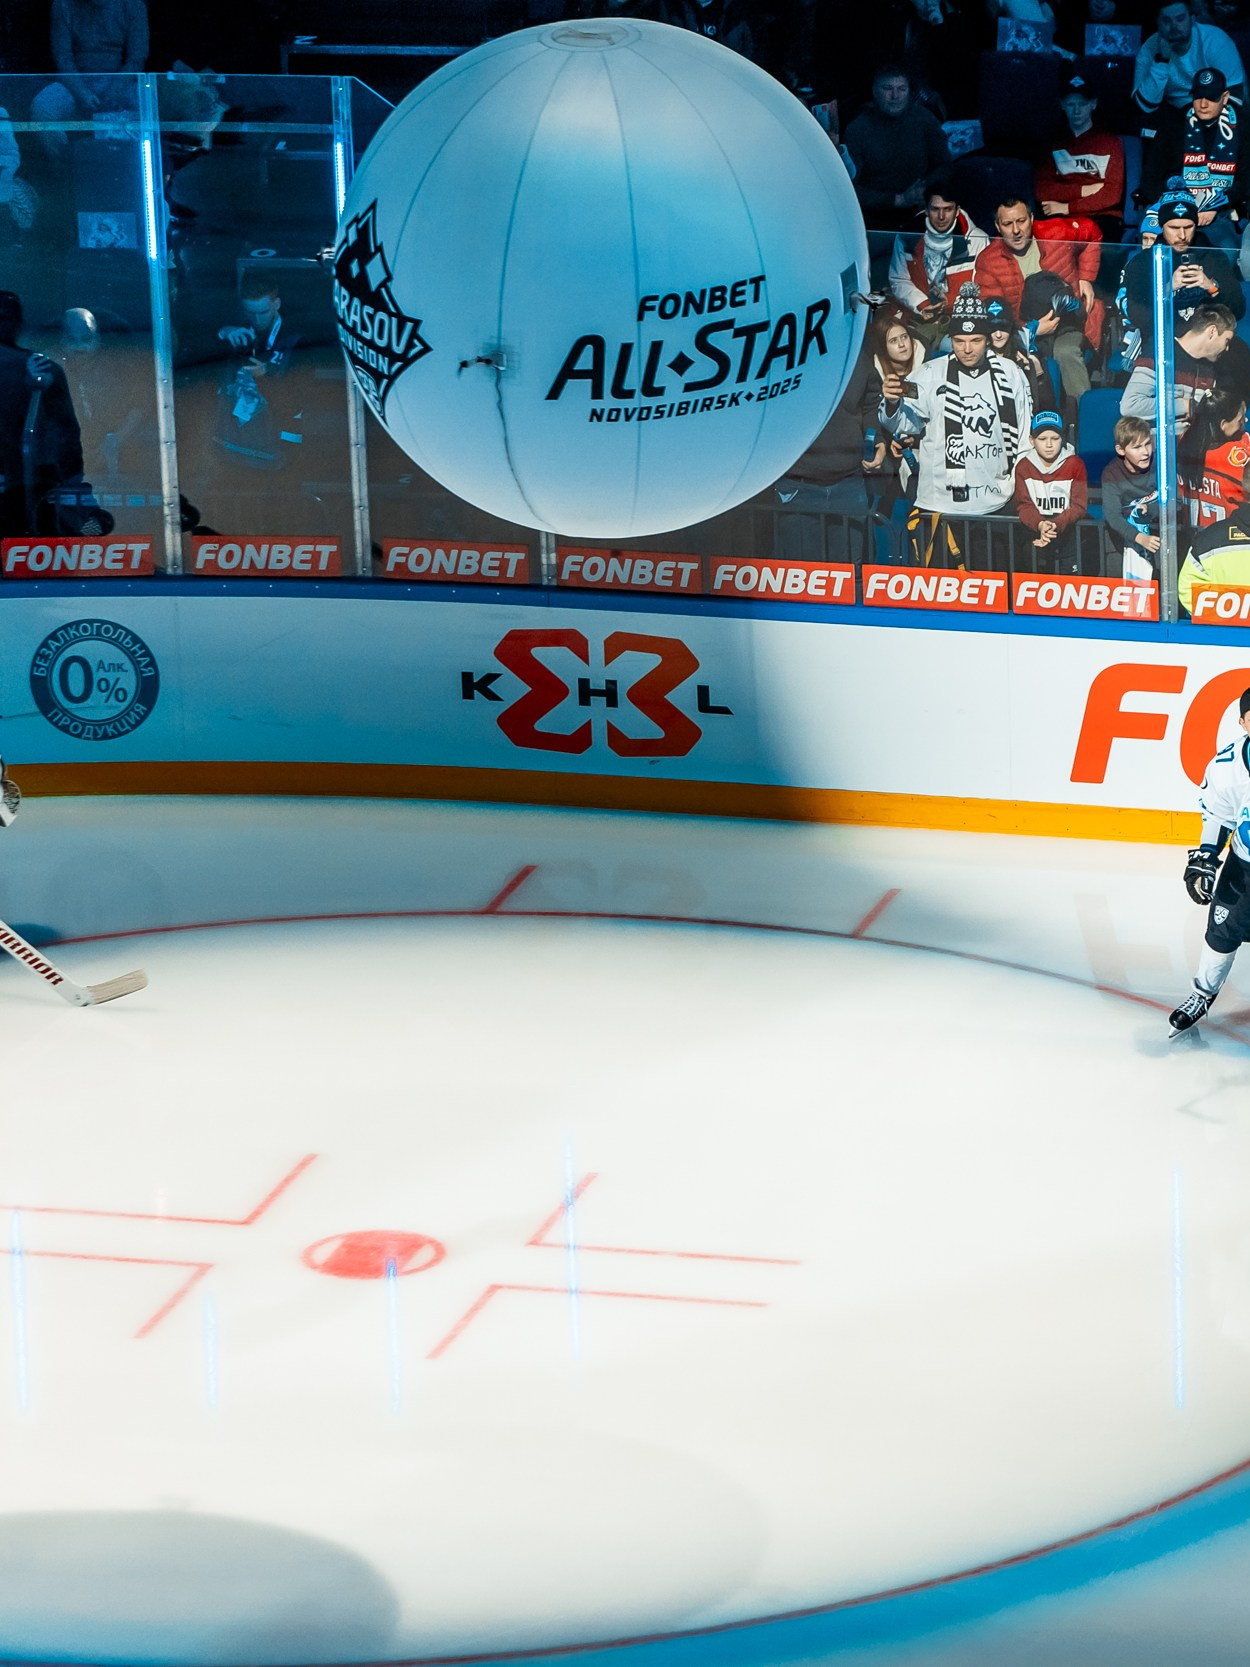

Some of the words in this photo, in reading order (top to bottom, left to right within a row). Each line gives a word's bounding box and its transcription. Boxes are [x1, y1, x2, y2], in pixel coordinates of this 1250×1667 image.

[637, 275, 766, 322] FONBET
[334, 286, 415, 354] ARASOV
[965, 443, 1004, 459] АКТОР
[6, 543, 150, 572] FONBET
[195, 543, 338, 571] FONBET
[386, 546, 526, 578] FONBET
[561, 555, 700, 588] FONBET
[713, 564, 852, 597] FONBET
[866, 573, 1004, 606] FONBET
[1015, 581, 1156, 613] FONBET
[33, 623, 155, 677] БЕЗАЛКОГОЛЬНАЯ
[47, 703, 147, 740] ПРОДУКЦИЯ
